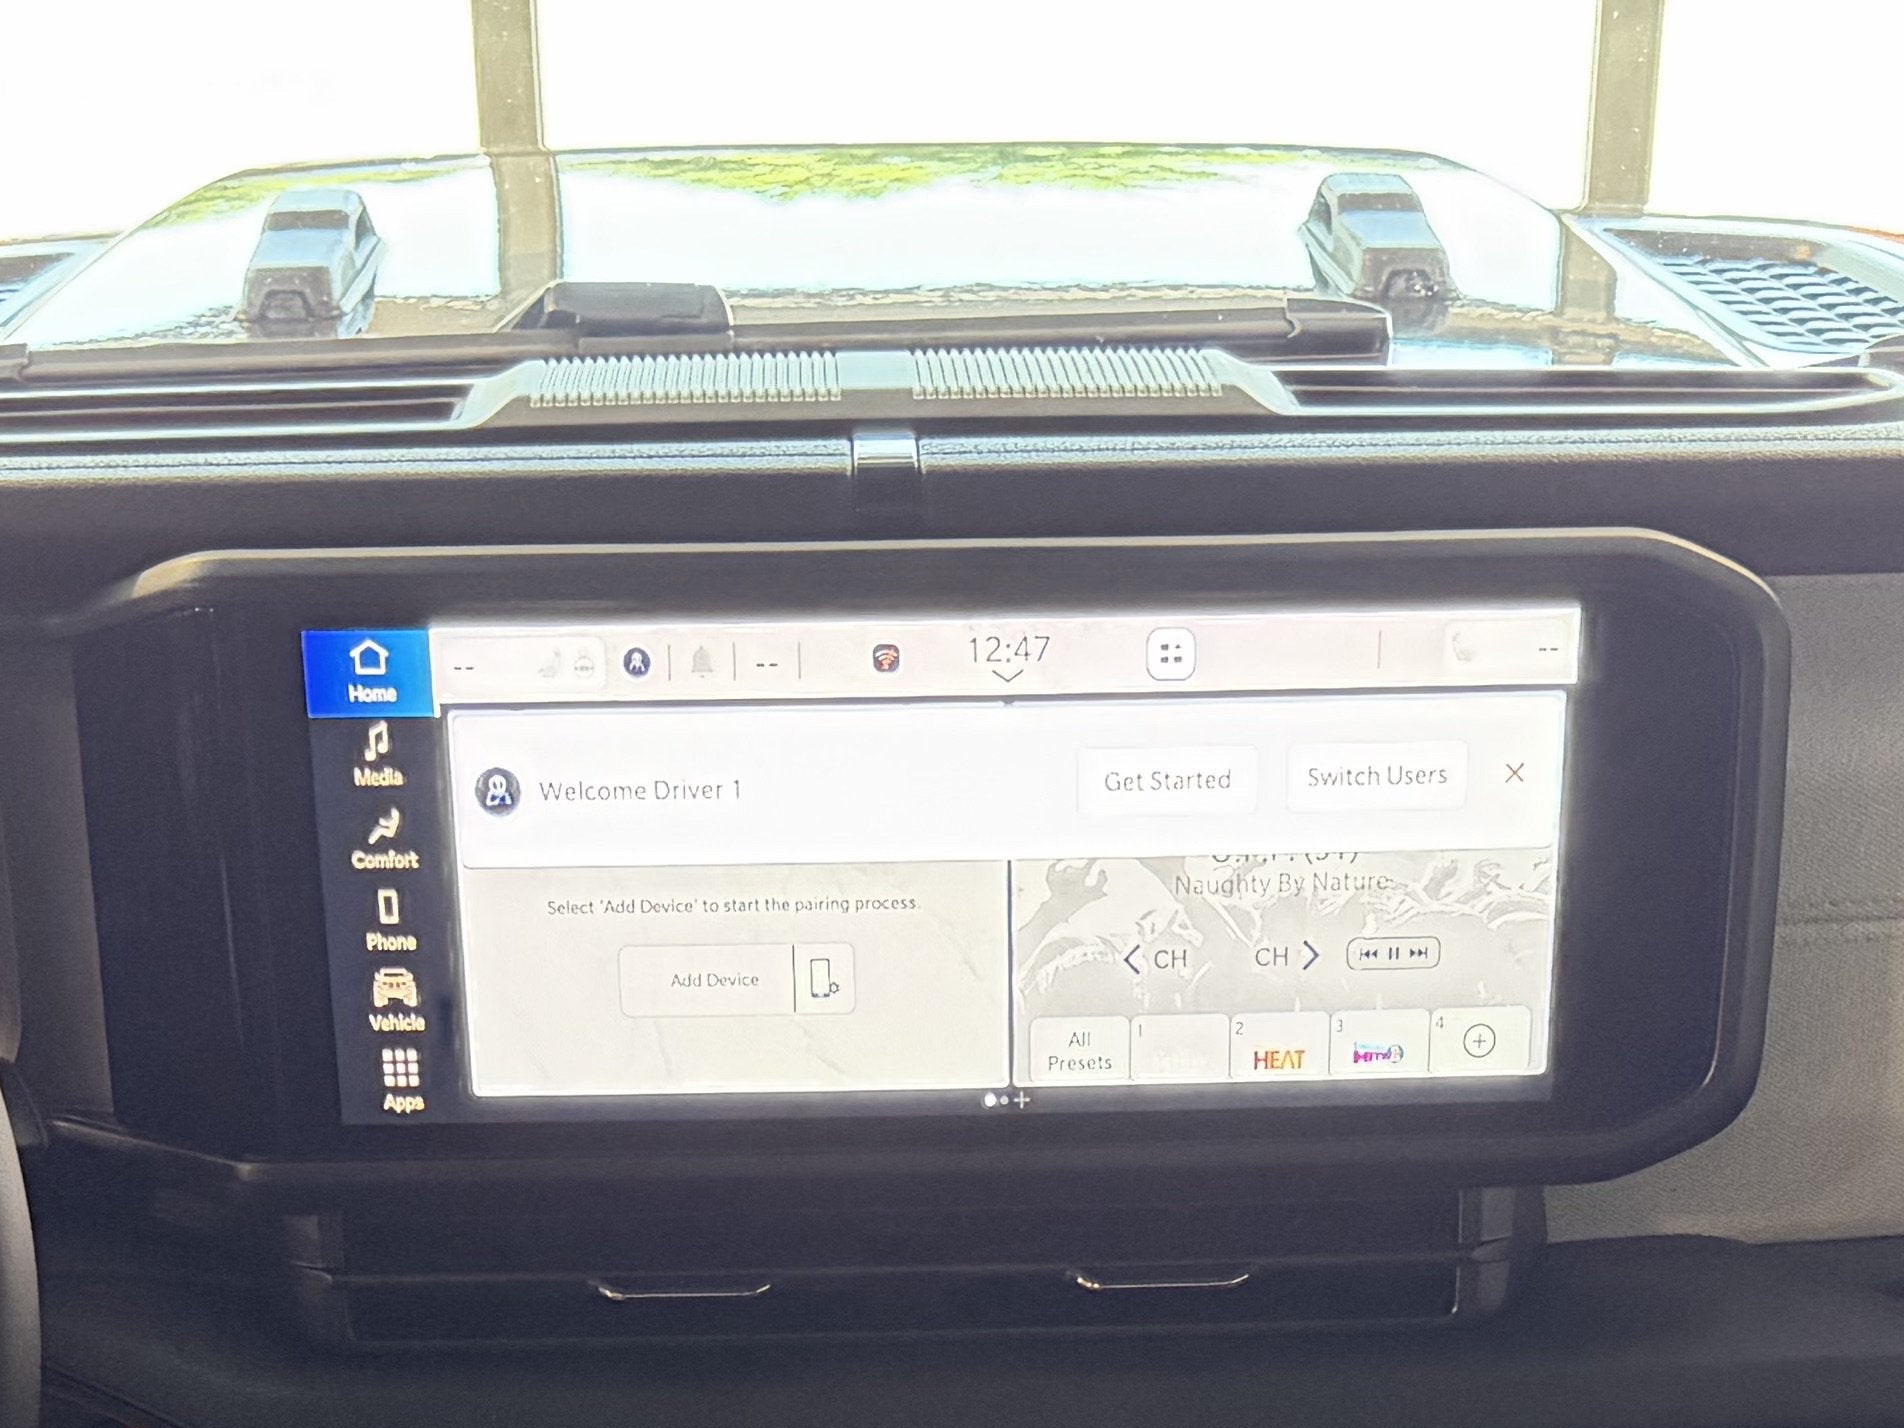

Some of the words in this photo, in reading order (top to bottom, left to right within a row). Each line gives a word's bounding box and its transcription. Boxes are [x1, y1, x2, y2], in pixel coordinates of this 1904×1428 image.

[968, 636, 1051, 664] 12:47
[348, 685, 397, 704] Home
[354, 768, 403, 787] Media
[1104, 769, 1145, 792] Get
[1151, 768, 1232, 791] Started
[1307, 765, 1381, 787] Switch
[1386, 764, 1449, 786] Users
[539, 780, 646, 801] Welcome
[653, 780, 726, 801] Driver
[732, 780, 742, 801] 1
[351, 851, 419, 869] Comfort
[1174, 874, 1271, 899] Naughty
[1278, 873, 1305, 896] By
[1312, 871, 1391, 893] Nature
[547, 899, 594, 916] Select
[702, 898, 719, 914] to
[722, 898, 761, 914] start
[765, 896, 791, 913] the
[794, 896, 851, 916] pairing
[366, 934, 417, 951] Phone
[1154, 949, 1187, 969] CH
[1255, 947, 1288, 967] CH
[671, 972, 701, 988] Add
[706, 971, 759, 988] Device
[369, 1014, 425, 1032] Vehicle
[1234, 1021, 1245, 1036] 2
[1335, 1018, 1344, 1033] 3
[1435, 1016, 1445, 1030] 4
[1067, 1030, 1092, 1049] All
[1047, 1053, 1113, 1073] Presets
[1253, 1049, 1305, 1071] HEAT
[383, 1094, 425, 1112] Apps
